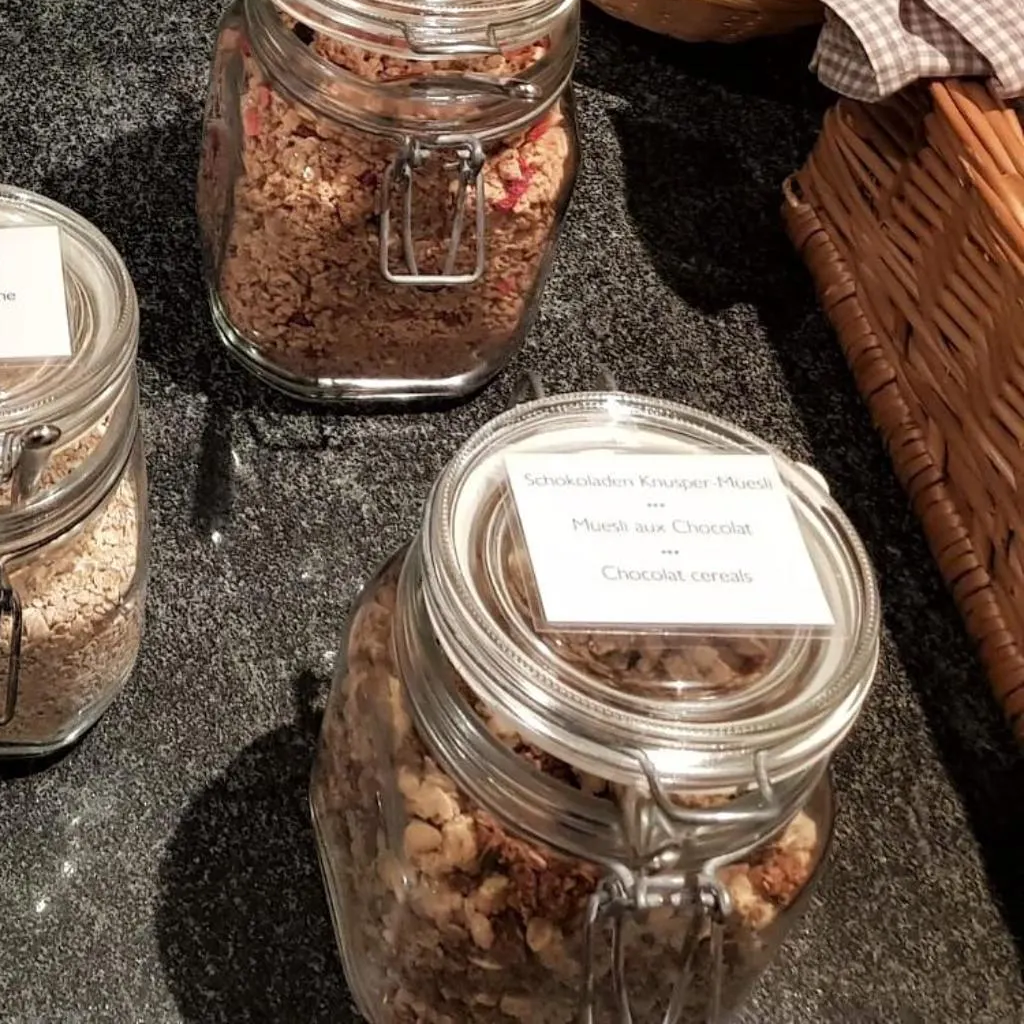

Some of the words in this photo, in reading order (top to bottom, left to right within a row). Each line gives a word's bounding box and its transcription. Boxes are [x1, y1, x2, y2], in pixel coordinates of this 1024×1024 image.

[524, 472, 634, 490] Schokoladen
[634, 521, 667, 534] aux
[671, 518, 753, 537] Chocolat
[601, 564, 685, 583] Chocolat
[690, 568, 754, 584] cereals
